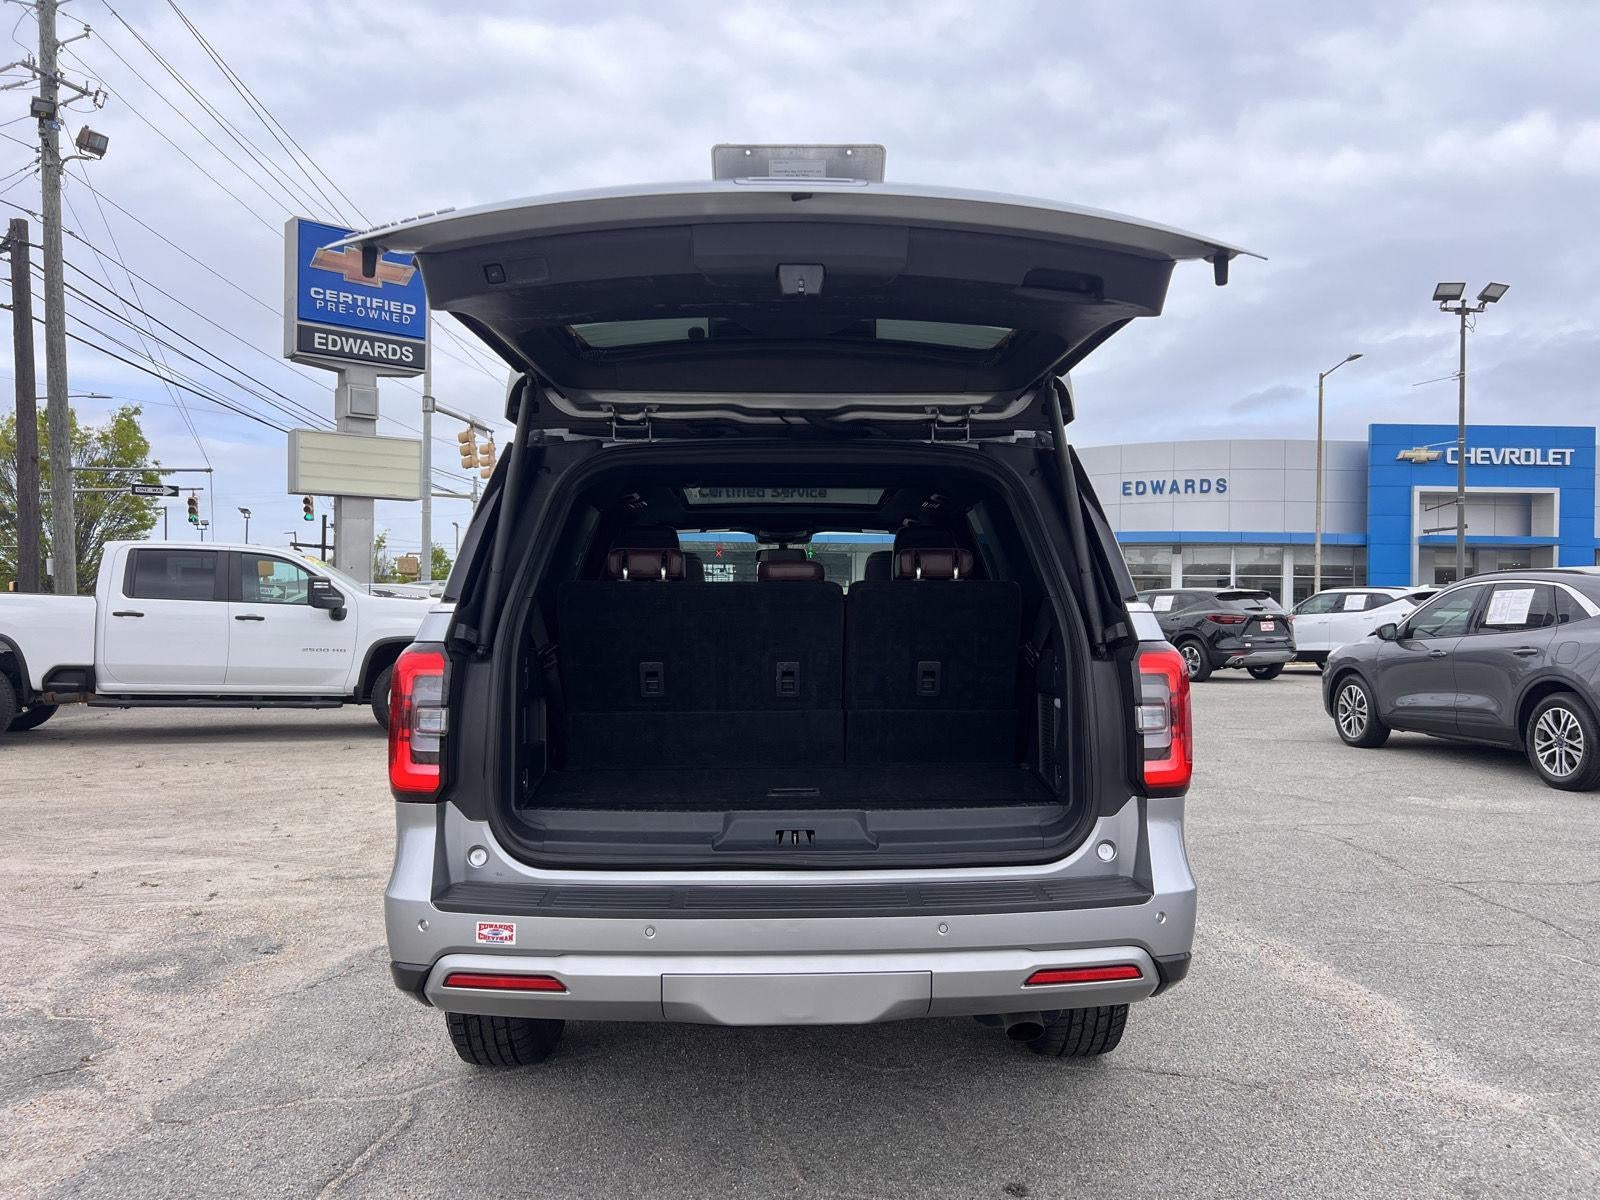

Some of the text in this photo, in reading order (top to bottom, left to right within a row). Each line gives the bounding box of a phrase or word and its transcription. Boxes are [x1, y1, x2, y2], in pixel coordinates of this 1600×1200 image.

[310, 287, 416, 315] CERTIFIED
[316, 300, 411, 324] PRE-OWNED
[314, 332, 414, 362] EDWARDS
[1446, 447, 1575, 466] CHEVROLET
[1122, 478, 1227, 496] EDWARDS
[478, 923, 514, 933] EDWARDS
